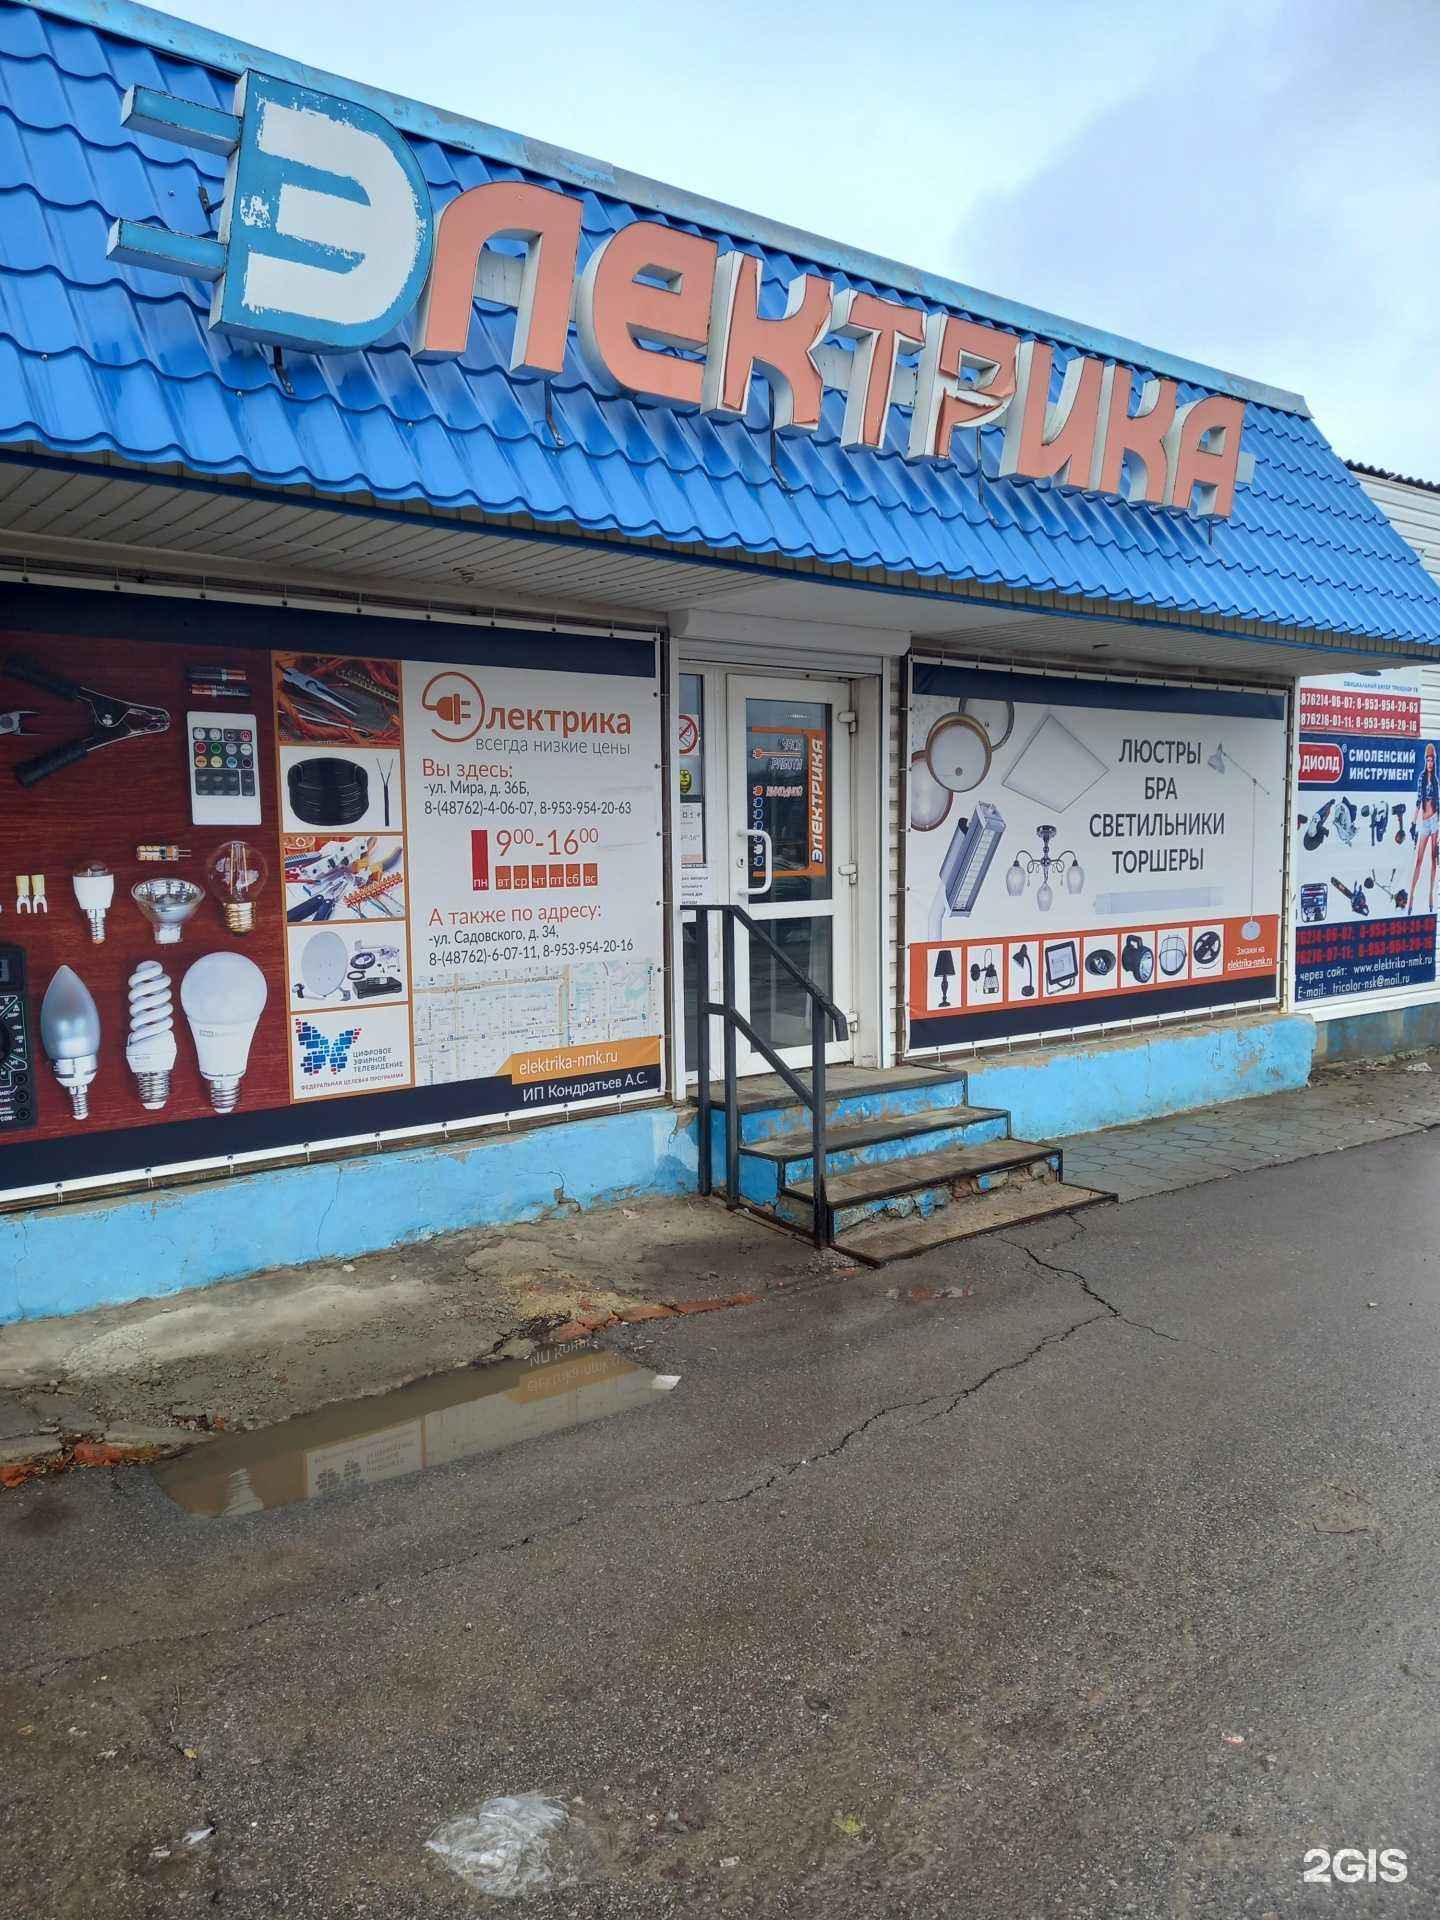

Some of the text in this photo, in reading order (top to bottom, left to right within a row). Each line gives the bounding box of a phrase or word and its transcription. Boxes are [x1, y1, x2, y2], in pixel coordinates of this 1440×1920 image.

[475, 738, 631, 756] всегда низкие цены
[1118, 738, 1201, 764] ЛЮСТРЫ
[1349, 748, 1416, 764] СМОЛЕНСКИЙ
[422, 758, 513, 781] Вы здесь:
[1302, 754, 1340, 773] ДИОЛД
[1349, 767, 1414, 781] ИНСТРУМЕНТ
[450, 780, 487, 796] Мира,
[490, 783, 501, 796] д.
[504, 780, 530, 797] 36Б,
[1144, 776, 1178, 800] БРА
[539, 800, 632, 816] 8-953-954-20-63
[1089, 812, 1225, 838] СВЕТИЛЬНИКИ
[1112, 848, 1204, 874] ТОРШЕРЫ
[473, 873, 597, 889] пн вт ср чт пт сб вс
[428, 903, 602, 926] А также по адресу:
[454, 928, 525, 945] Садовского,
[528, 929, 540, 942] д.
[542, 924, 560, 940] 34,
[543, 939, 634, 959] 8-953-954-20-16
[1300, 970, 1324, 984] через
[1298, 984, 1327, 999] E-mail:
[353, 1048, 392, 1058] ЦИФРОВОЕ
[353, 1061, 403, 1073] ТЕЛЕВИДЕНИЕ
[519, 1050, 619, 1076] elektrika-nmk.ru
[523, 1072, 648, 1102] ИП Кондратьев А.С.
